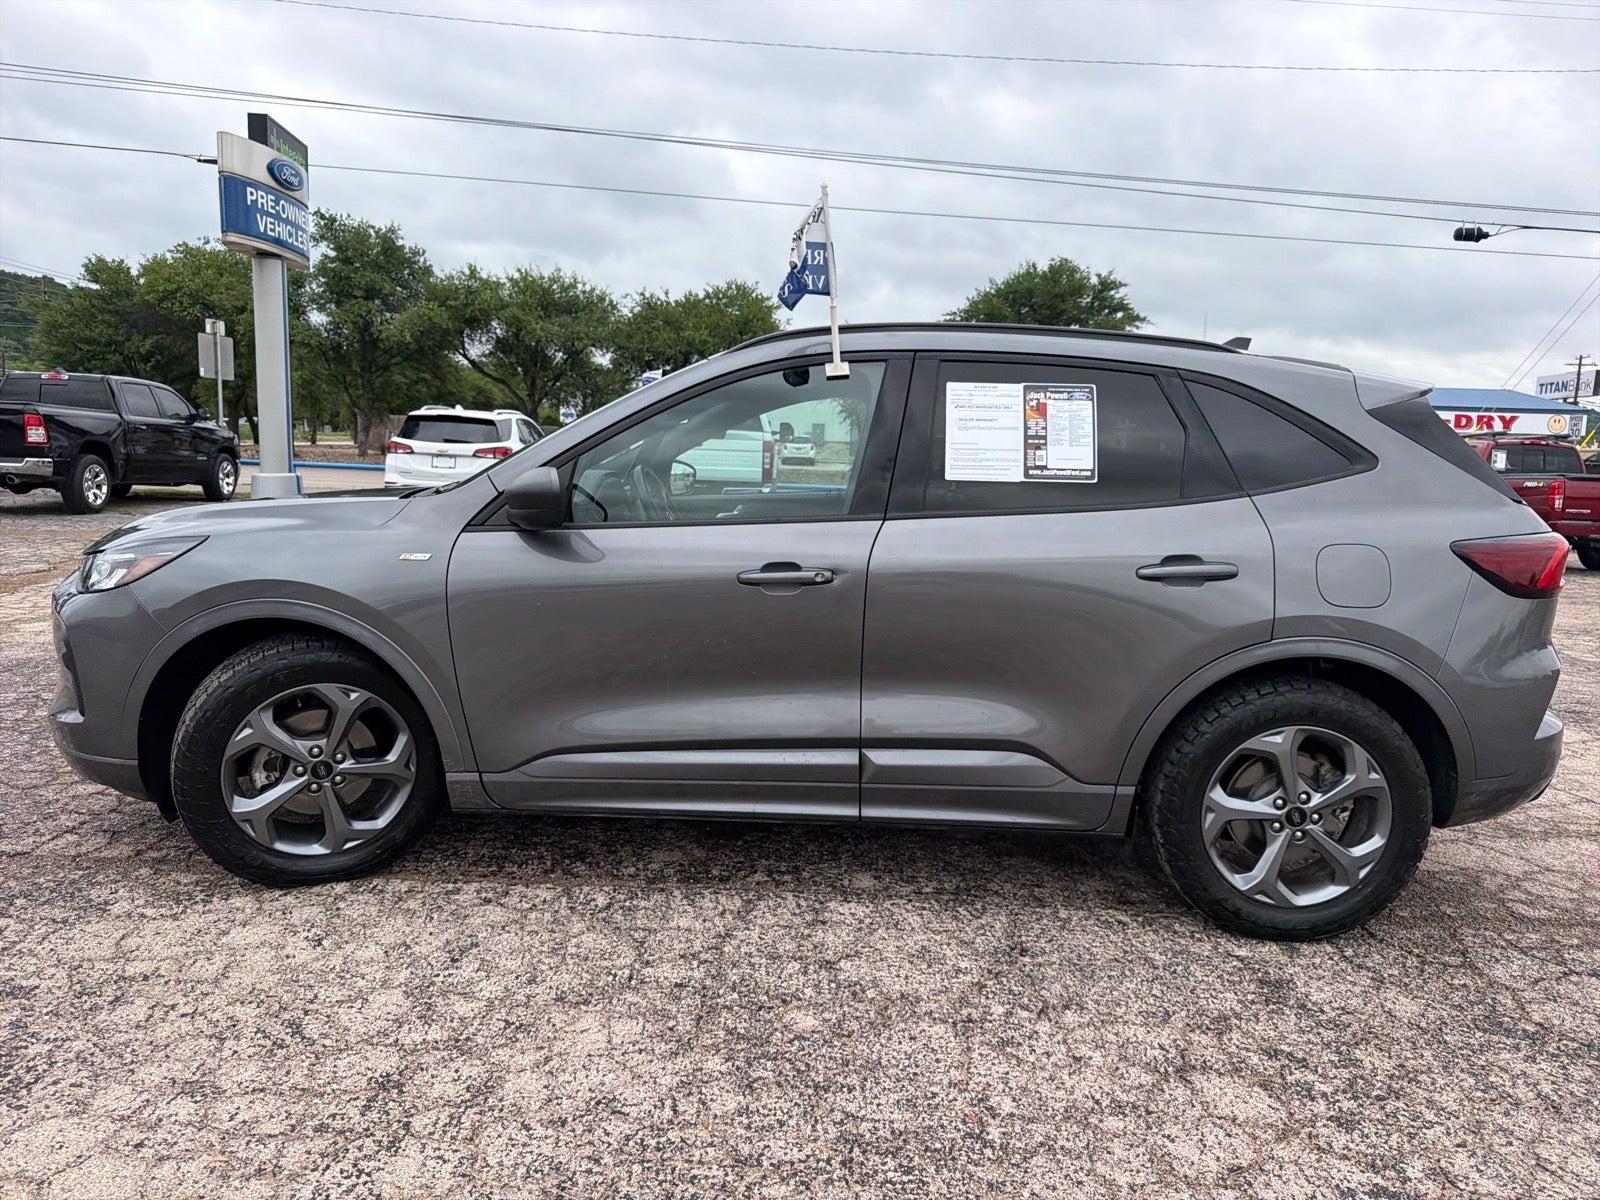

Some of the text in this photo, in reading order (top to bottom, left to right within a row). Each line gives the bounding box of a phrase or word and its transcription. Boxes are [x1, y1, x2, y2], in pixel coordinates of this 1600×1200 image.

[281, 166, 299, 187] Ford
[256, 213, 308, 250] VEHICLES
[1539, 379, 1593, 394] TITANBnk
[1029, 391, 1045, 399] Jack
[1046, 391, 1068, 400] Powell
[1570, 428, 1580, 438] 30
